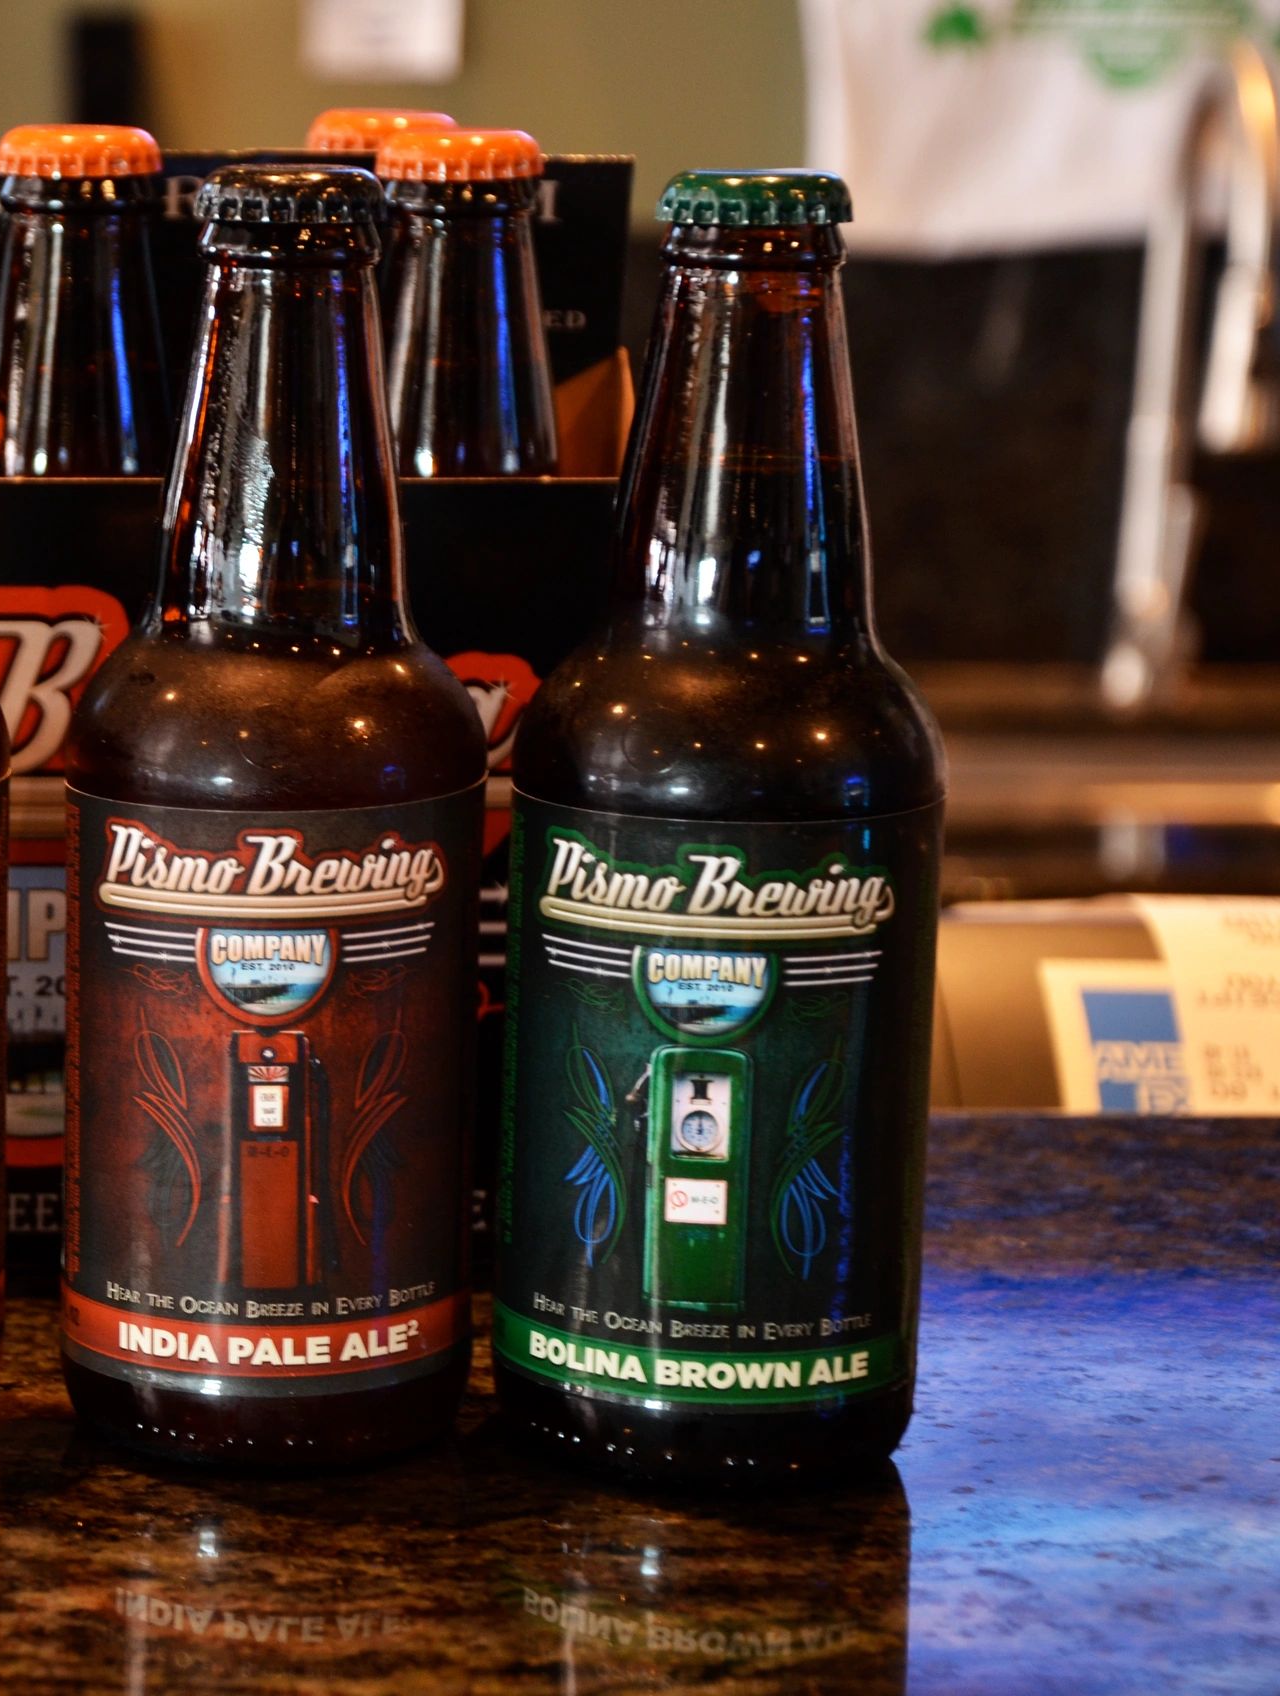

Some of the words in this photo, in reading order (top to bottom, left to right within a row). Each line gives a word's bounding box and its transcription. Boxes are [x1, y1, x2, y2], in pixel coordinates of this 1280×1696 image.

[110, 824, 245, 895] Pismo
[245, 835, 443, 899] Brewing
[548, 838, 685, 910] Pismo
[687, 854, 895, 925] Brewing
[211, 933, 326, 965] COMPANY
[648, 952, 766, 987] COMPANY
[106, 1281, 141, 1304] HEAR
[146, 1293, 174, 1310] THE
[180, 1296, 239, 1316] OCEAN
[245, 1301, 304, 1319] BREEZE
[312, 1303, 329, 1315] IN
[335, 1294, 382, 1315] EVERY
[389, 1282, 436, 1307] BOTTLE
[533, 1292, 565, 1316] HEAR
[571, 1306, 598, 1325] THE
[603, 1311, 662, 1335] OCEAN
[670, 1319, 730, 1339] BREEZE
[738, 1324, 756, 1339] IN
[762, 1322, 814, 1341] EVERY
[820, 1313, 872, 1337] BOTTLE
[118, 1321, 218, 1363] INDIA
[227, 1336, 331, 1366] PALE
[529, 1330, 646, 1383] BOLINA
[654, 1358, 801, 1390] BROWN
[807, 1351, 869, 1386] ALE
